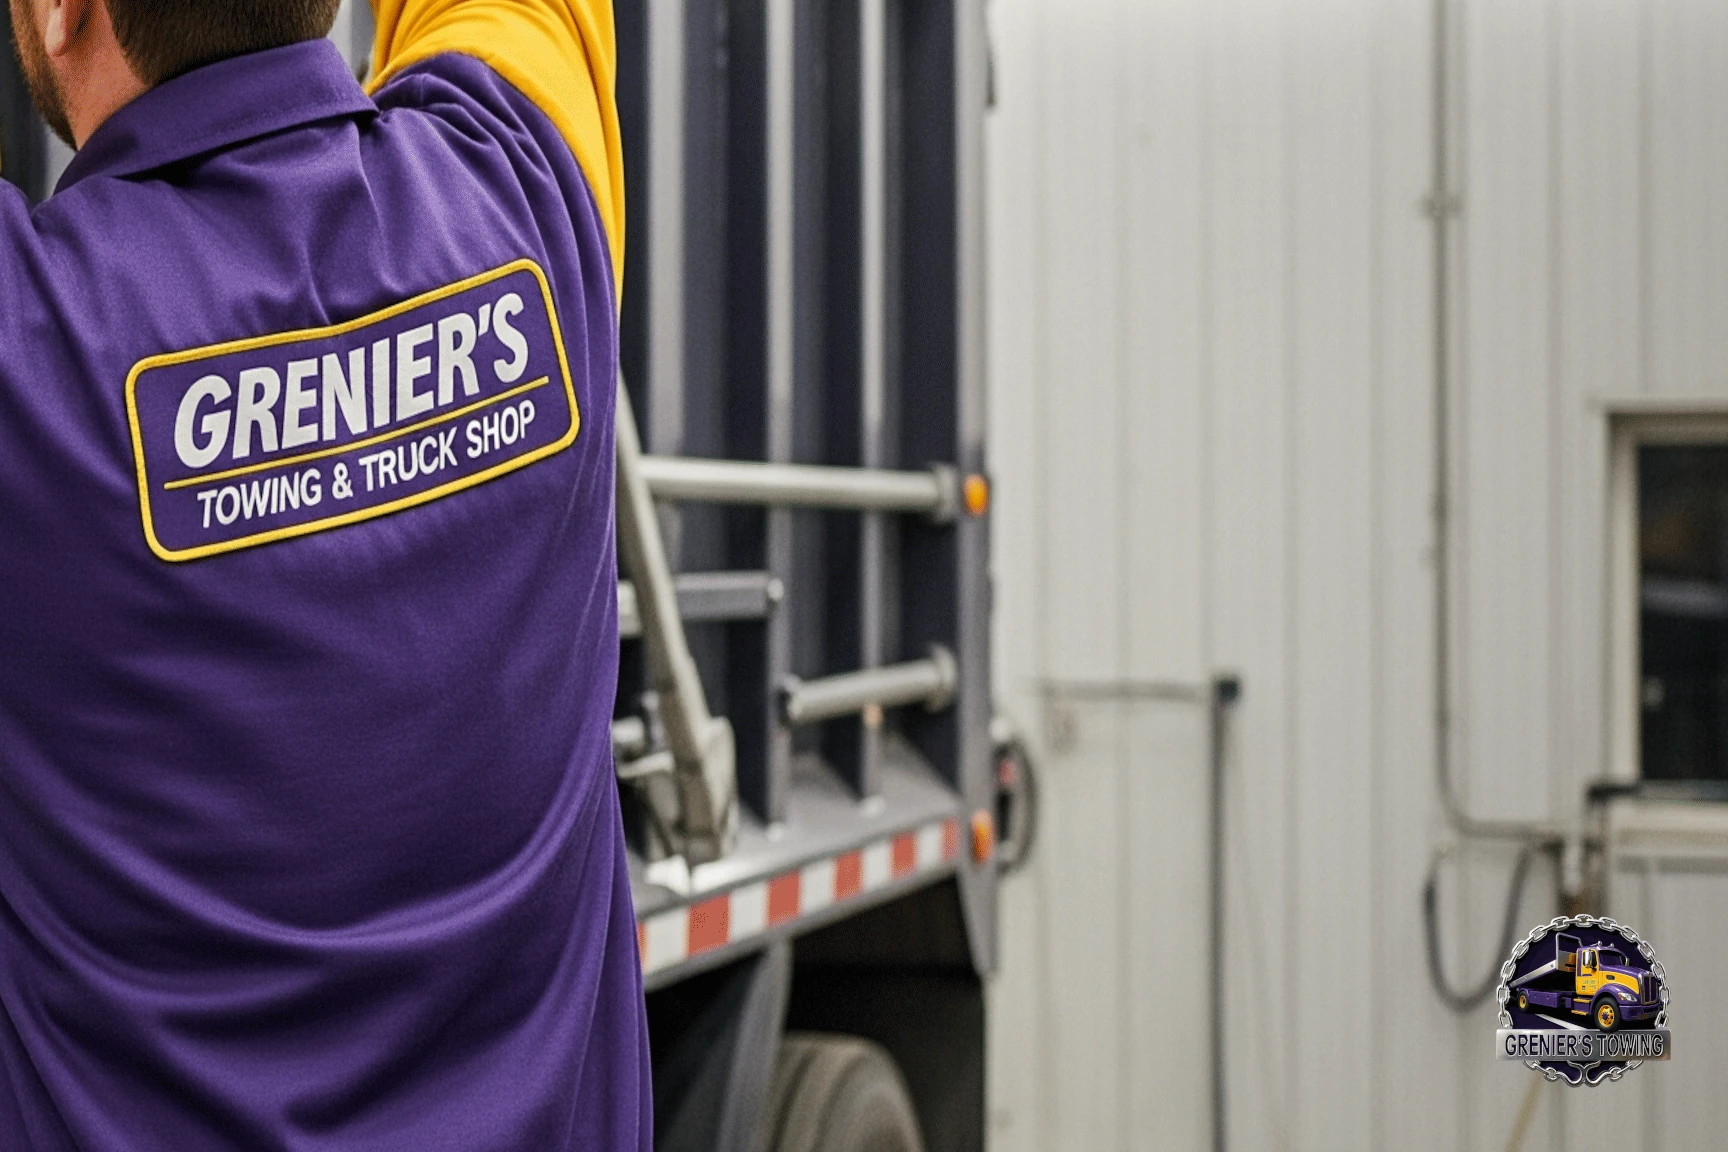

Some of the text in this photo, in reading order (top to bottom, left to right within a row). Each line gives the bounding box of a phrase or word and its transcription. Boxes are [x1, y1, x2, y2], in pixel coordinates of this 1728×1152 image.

[174, 292, 530, 469] GRENIER'S
[197, 399, 536, 530] TOWING & TRUCK SHOP
